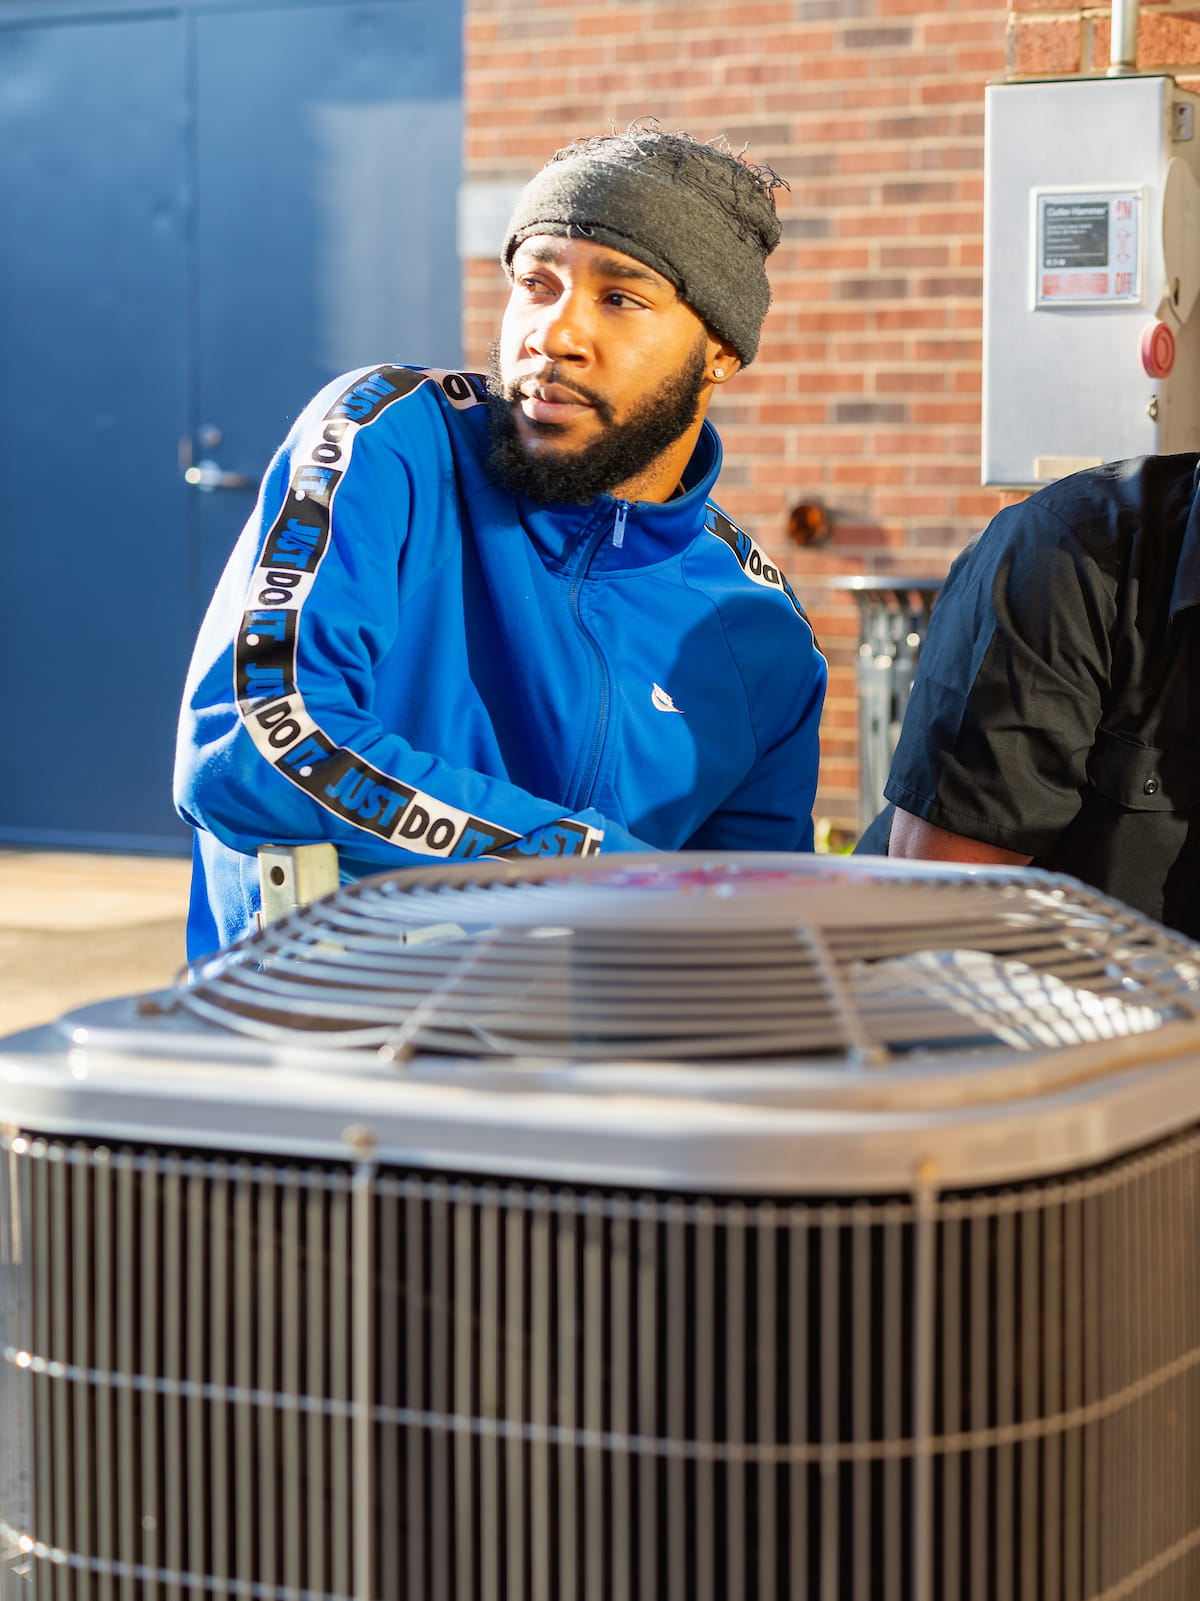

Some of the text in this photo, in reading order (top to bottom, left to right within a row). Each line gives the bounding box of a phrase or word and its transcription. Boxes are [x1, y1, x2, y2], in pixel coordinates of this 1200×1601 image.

[332, 373, 398, 420] JUST
[312, 422, 350, 463] DO
[271, 518, 322, 569] JUST
[258, 571, 302, 605] DO
[256, 702, 302, 748] DO
[324, 767, 409, 828] JUST
[399, 804, 456, 850] DO
